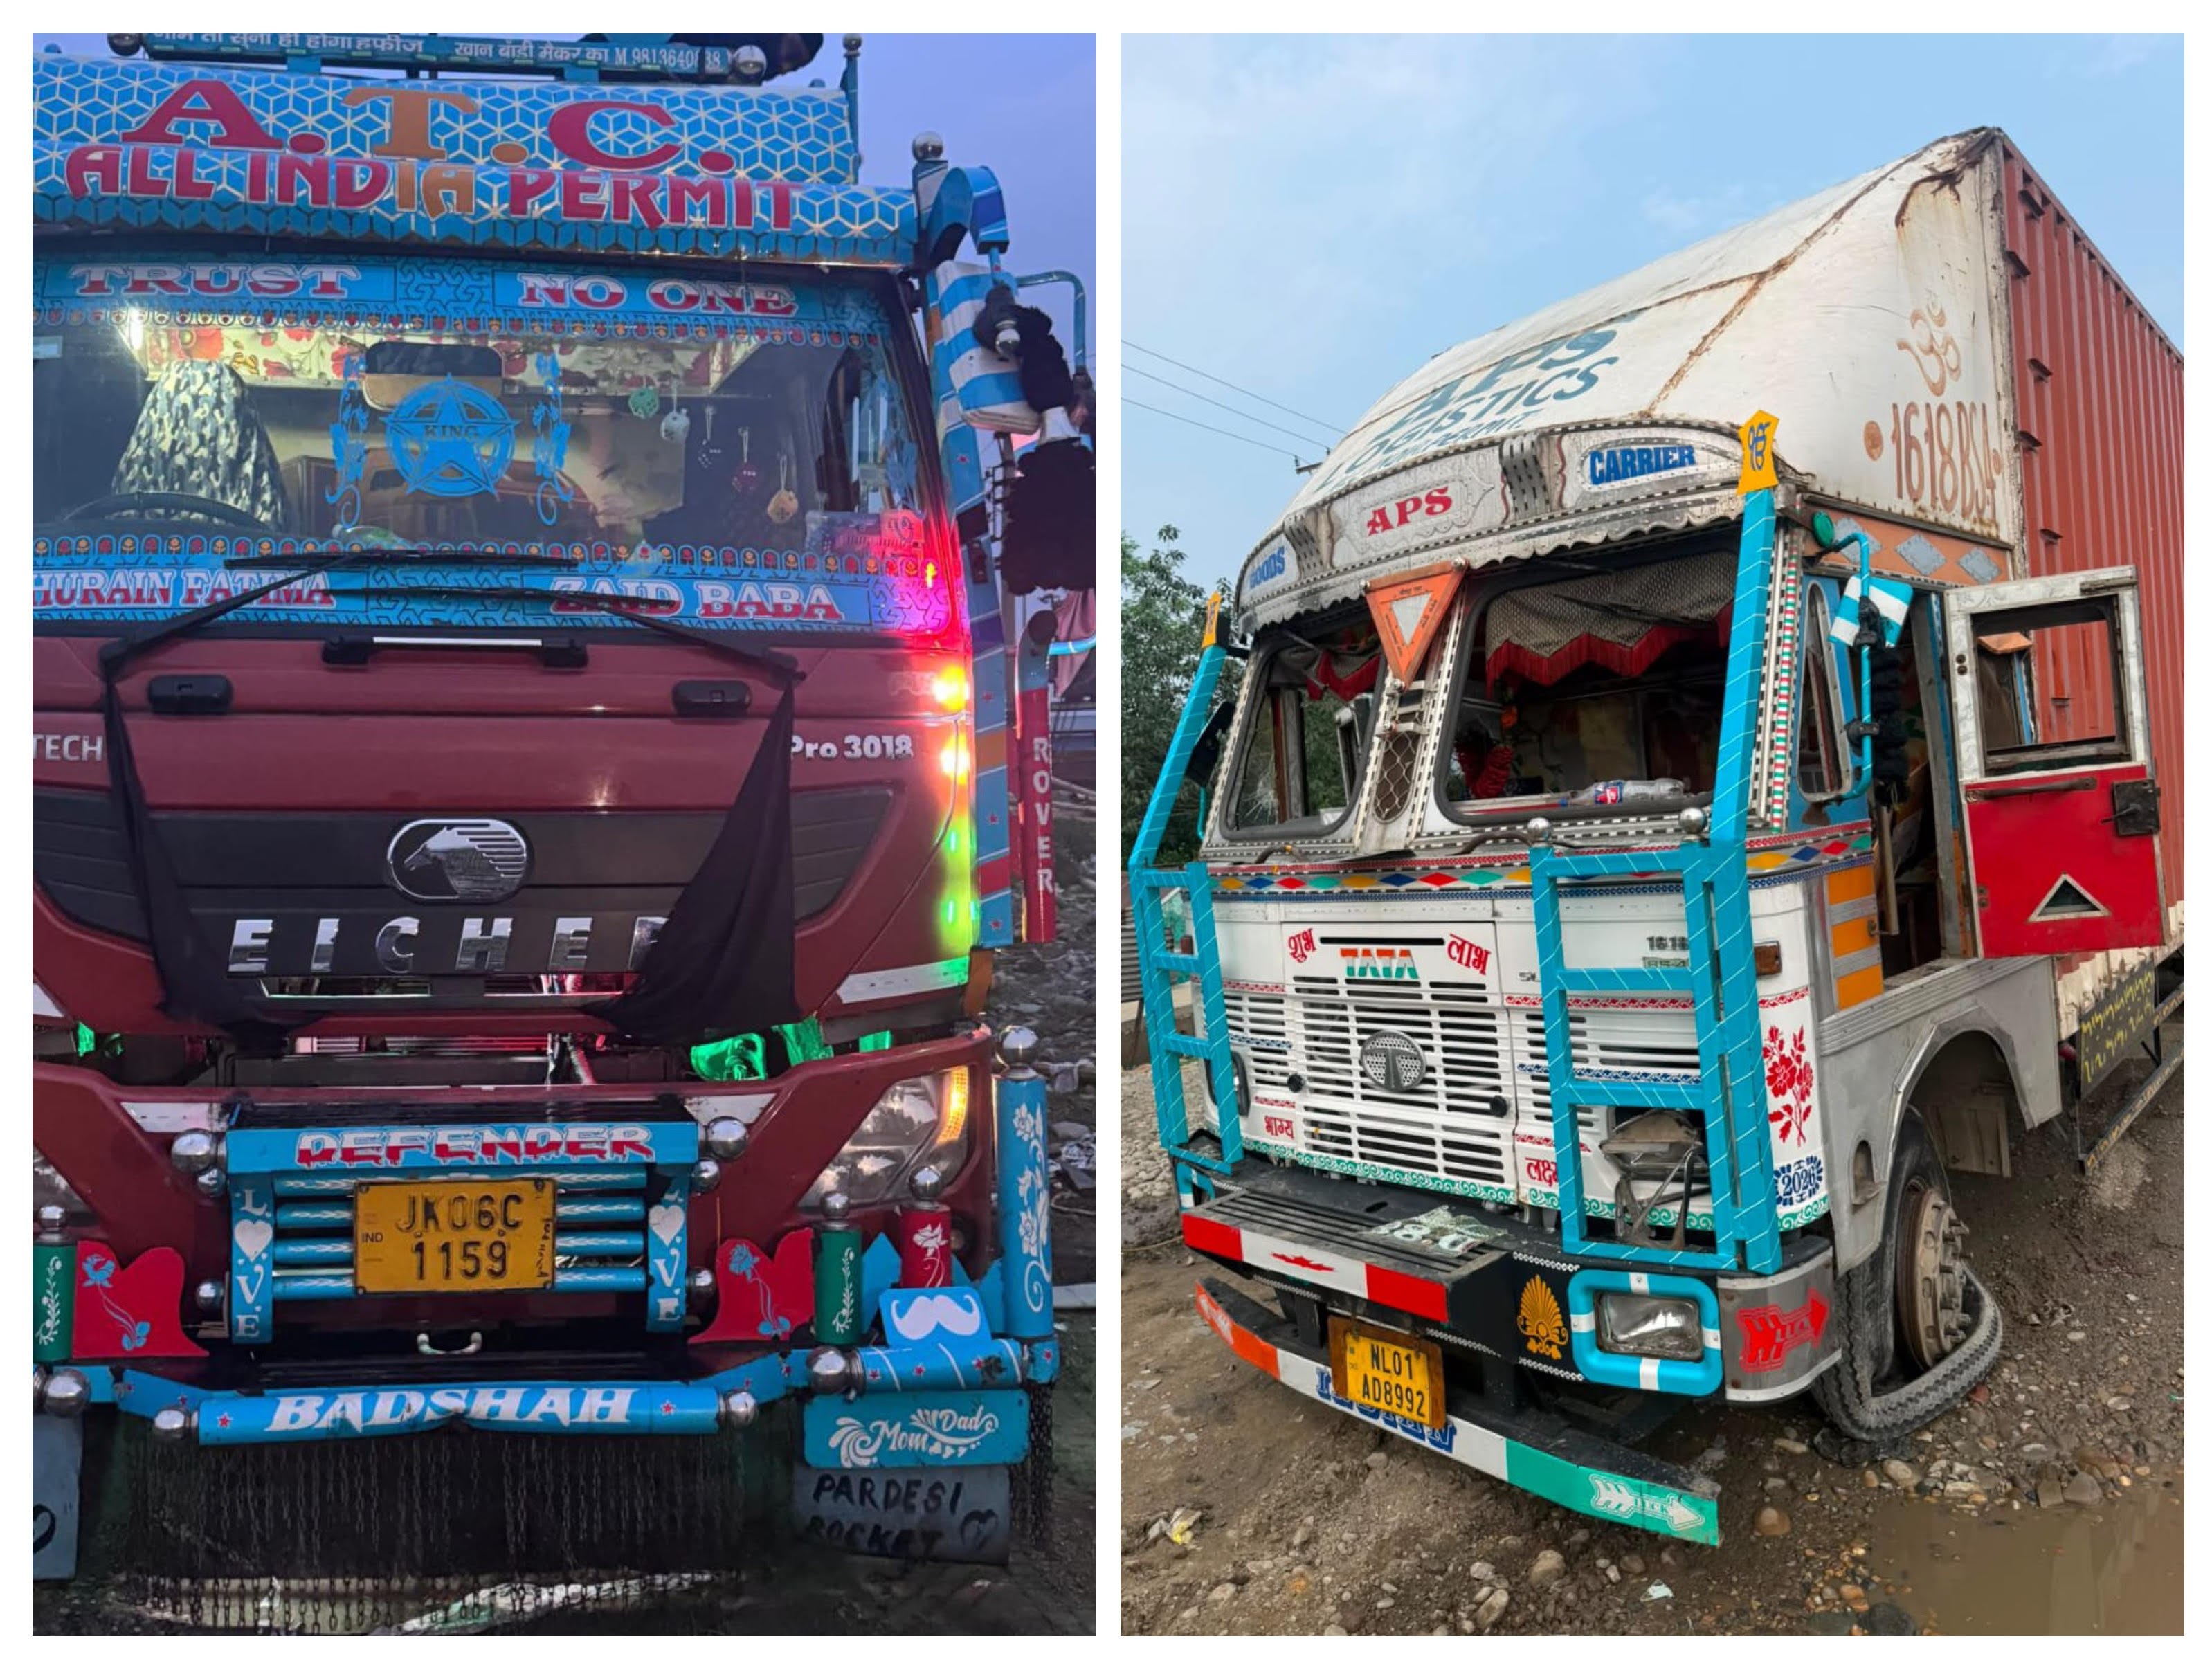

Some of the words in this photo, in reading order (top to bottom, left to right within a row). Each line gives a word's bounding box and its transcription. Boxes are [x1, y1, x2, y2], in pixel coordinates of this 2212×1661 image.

[585, 47, 609, 62] का
[615, 48, 626, 66] M
[66, 145, 215, 200] ALL
[246, 152, 475, 220] INDIA
[509, 168, 804, 230] PERMIT
[71, 262, 361, 298] TRUST
[517, 273, 628, 311] NO
[647, 277, 798, 316] ONE
[424, 424, 479, 444] KING
[1313, 356, 1620, 493] LOGISTICS
[1589, 445, 1696, 485] CARRIER
[1367, 486, 1452, 536] APS
[181, 568, 336, 608] FATIMA
[1250, 546, 1285, 590] GOODS
[551, 577, 684, 616] ZAID
[695, 582, 844, 621] BABA
[791, 734, 838, 759] Pro
[844, 734, 914, 760] 3018
[1033, 737, 1053, 893] ROVER
[1288, 928, 1316, 963] शुभ
[1340, 948, 1419, 979] TATA
[1447, 933, 1492, 976] लाभ
[295, 1125, 655, 1168] DEFENDER
[1782, 1165, 1816, 1196] 2026
[396, 1194, 523, 1232] JK06C
[361, 1232, 383, 1243] IND
[413, 1240, 509, 1280] 1159
[1370, 1343, 1413, 1380] NL01
[264, 1387, 640, 1433] BADSHAH
[1362, 1372, 1426, 1418] AD8992
[869, 1419, 928, 1453] Mom
[941, 1406, 984, 1433] Dad
[813, 1474, 963, 1514] PARDESI
